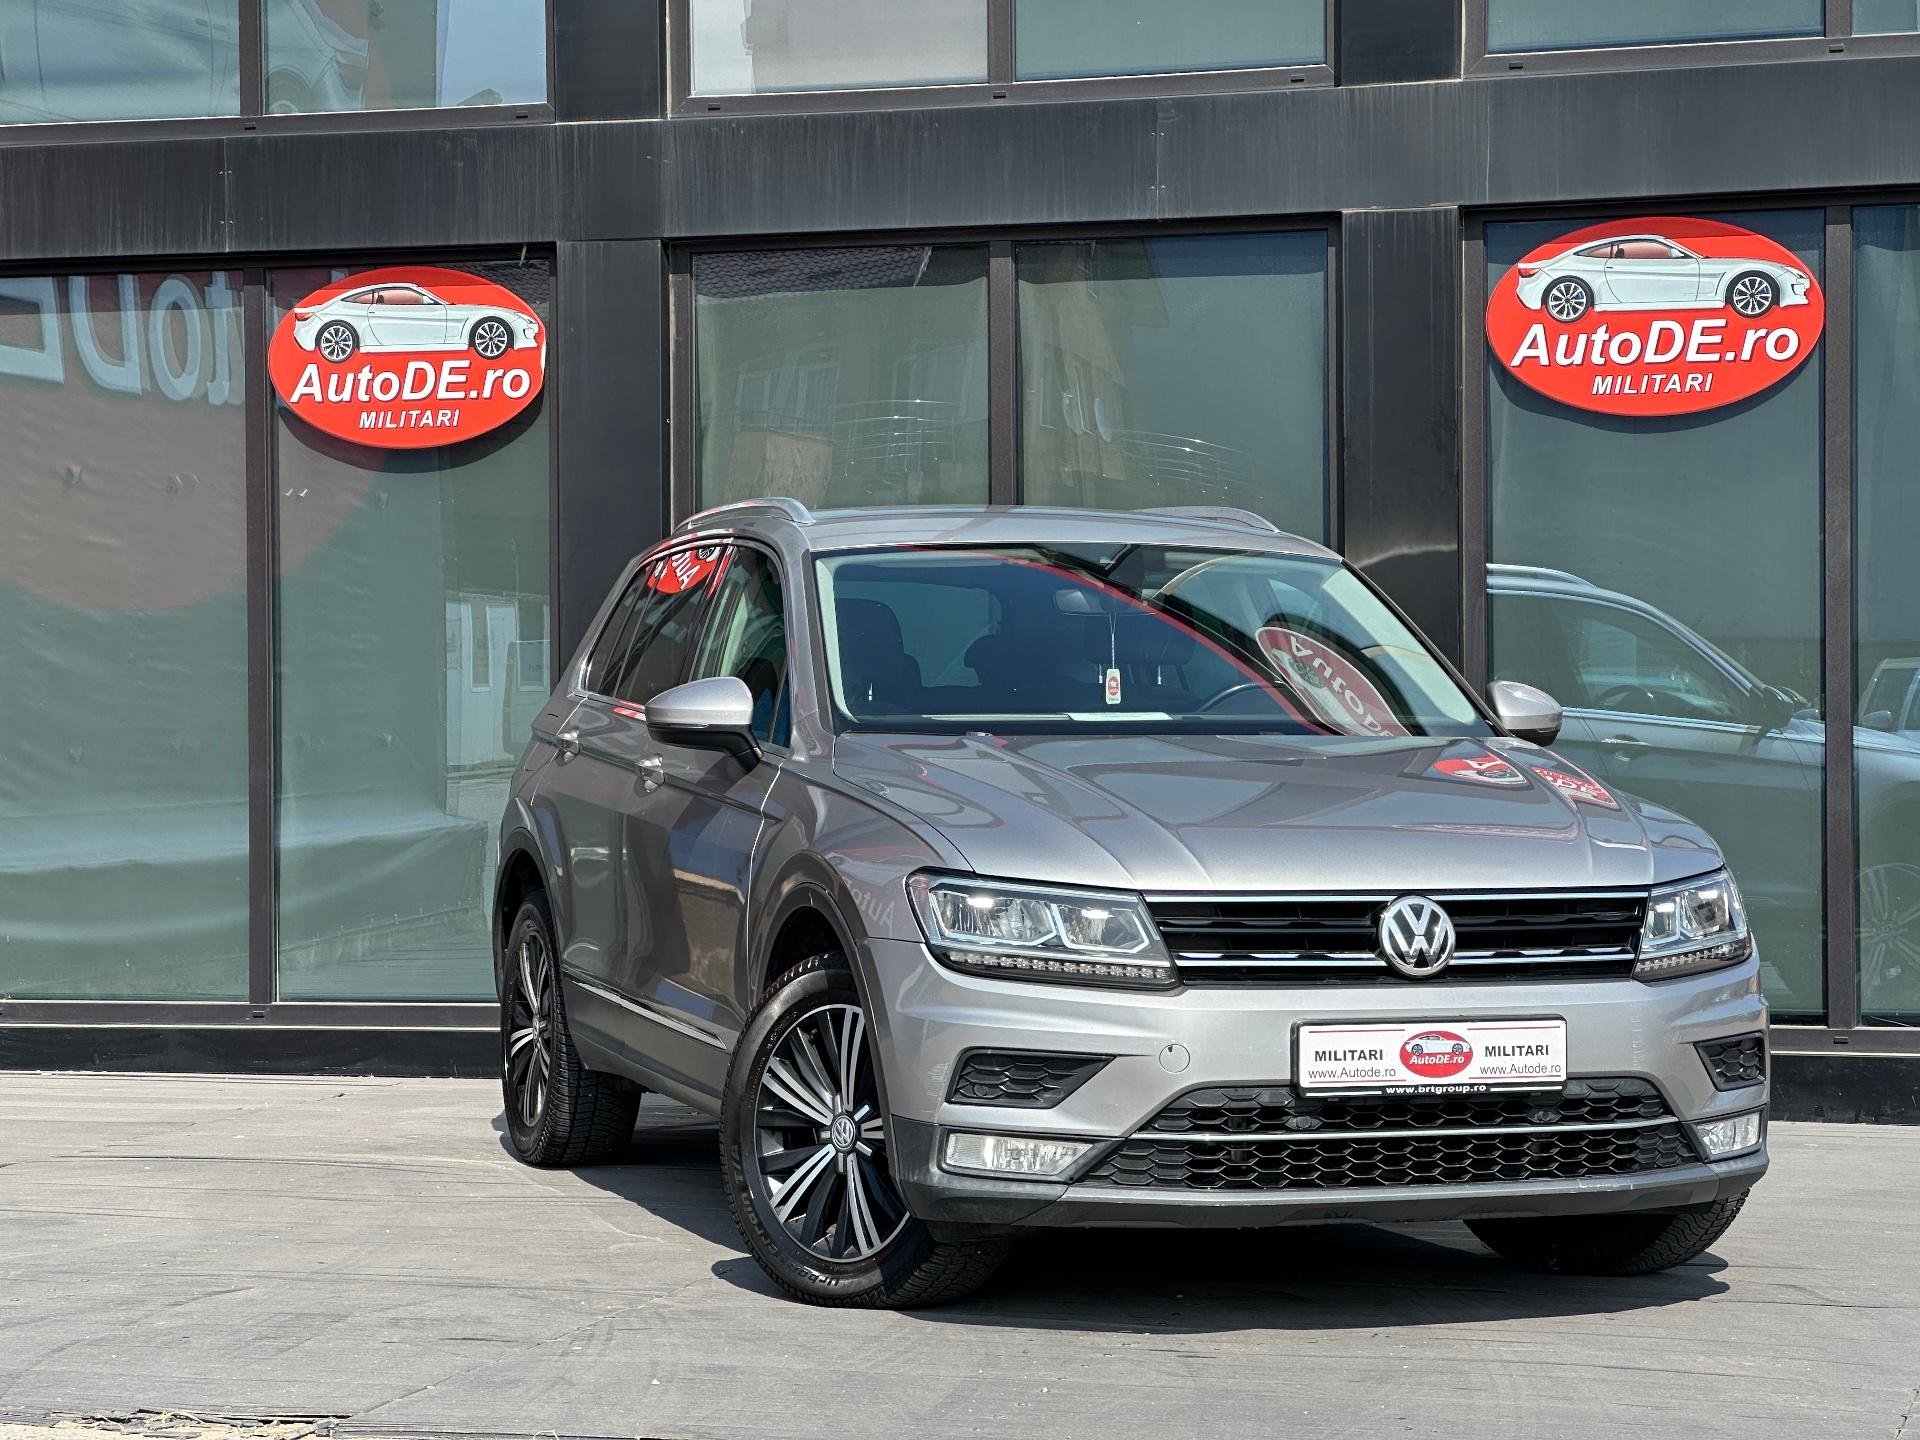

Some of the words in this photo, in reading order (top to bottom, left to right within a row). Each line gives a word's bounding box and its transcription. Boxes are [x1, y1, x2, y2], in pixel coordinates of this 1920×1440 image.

[1510, 318, 1800, 368] AutoDE.ro
[290, 359, 532, 404] AutoDE.ro
[1591, 372, 1713, 396] MILITARI
[358, 409, 461, 430] MILITARI
[1314, 1049, 1384, 1062] MILITARI
[1484, 1045, 1550, 1058] MILITARI
[1409, 1054, 1465, 1065] AutoDE.ro
[1308, 1066, 1396, 1079] www.Autode.ro
[1479, 1063, 1562, 1075] www.Autode.ro
[1385, 1084, 1487, 1095] www.brtgroup.ro
